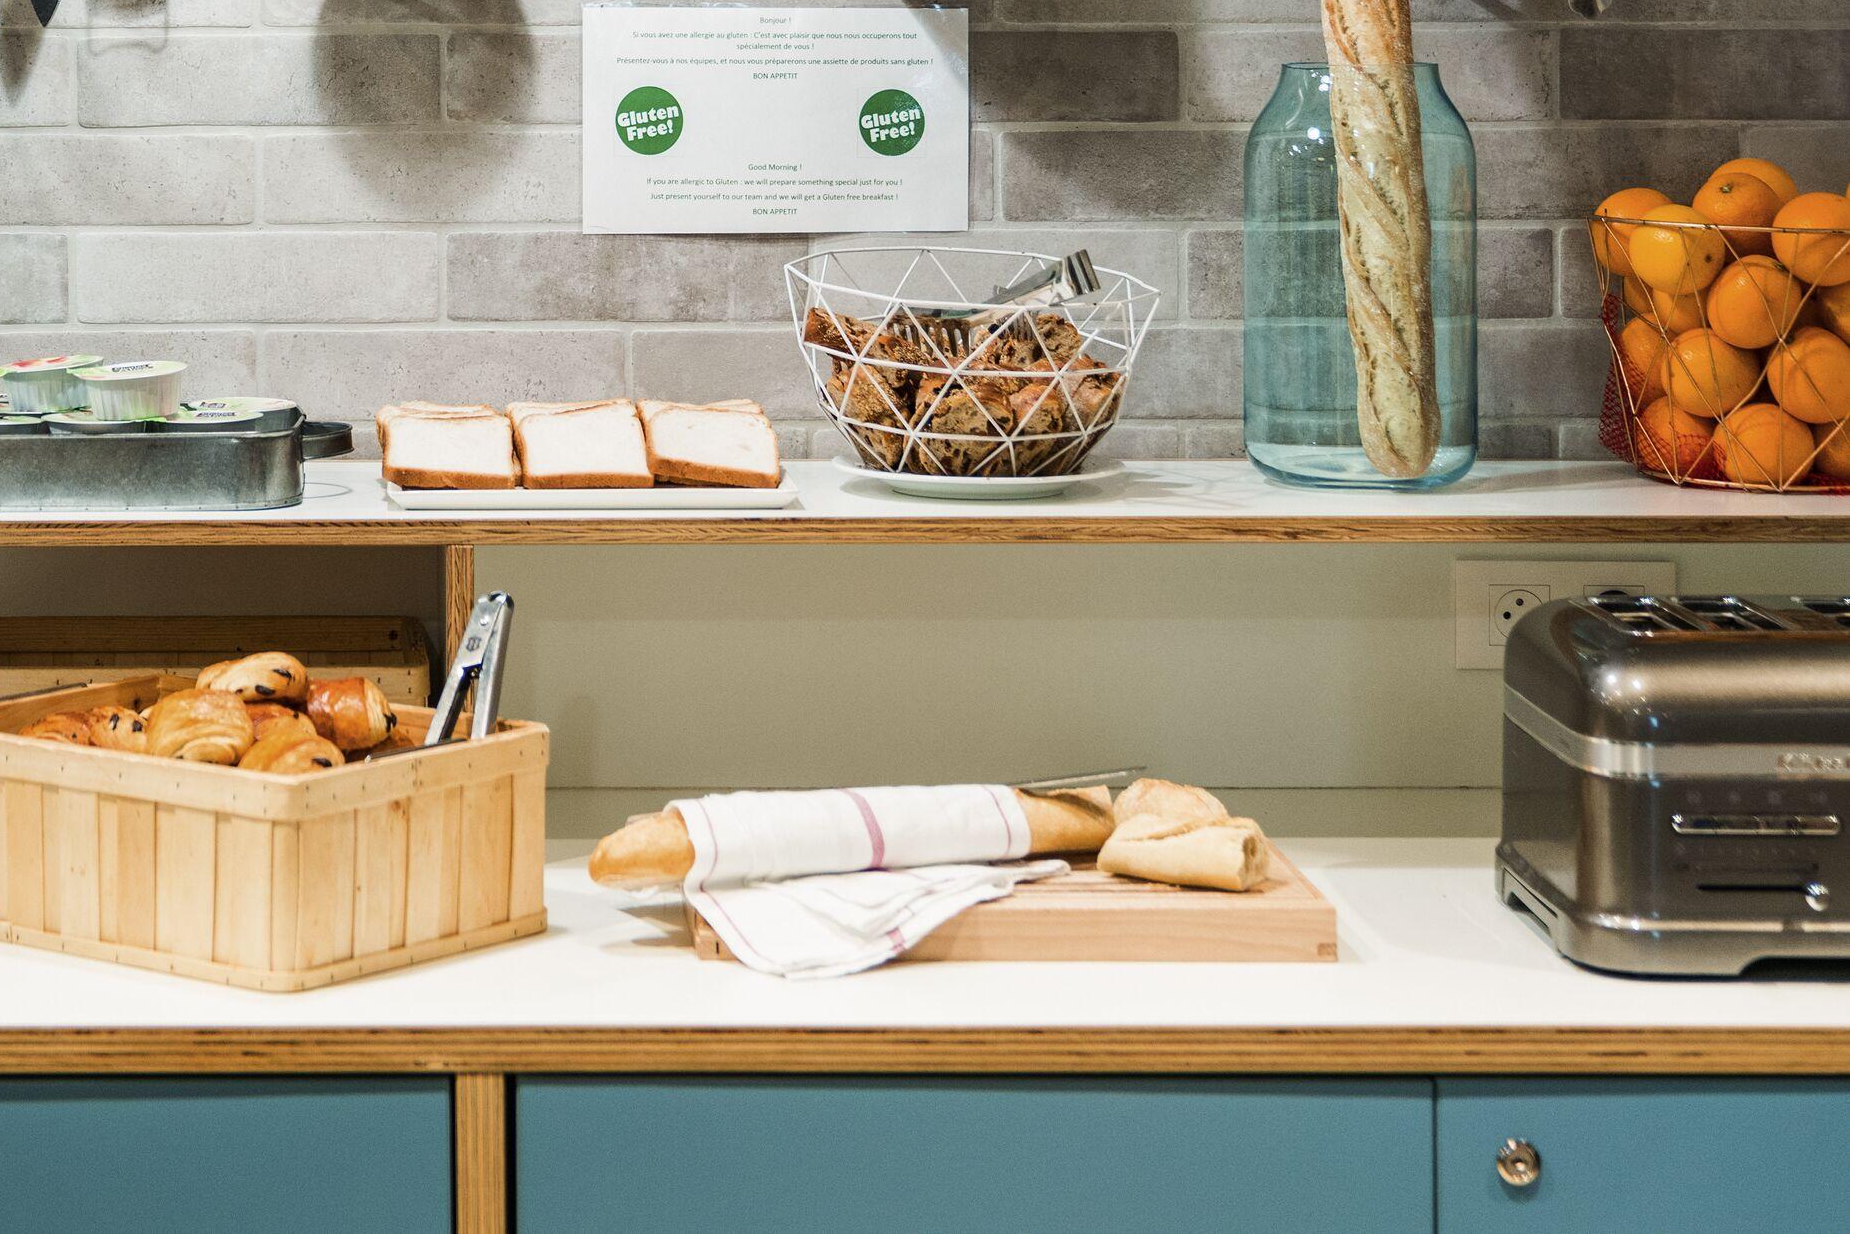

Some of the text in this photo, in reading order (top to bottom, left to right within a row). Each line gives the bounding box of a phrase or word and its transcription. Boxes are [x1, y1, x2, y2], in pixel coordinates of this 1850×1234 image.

[759, 17, 787, 26] Bonjour
[689, 32, 715, 41] allergie
[726, 32, 748, 41] gluten
[789, 32, 810, 41] plaisir
[811, 33, 824, 41] que
[736, 43, 782, 52] spécialement
[690, 58, 719, 66] équipes,
[764, 58, 806, 66] préparerons
[860, 58, 889, 67] produits
[906, 58, 929, 67] gluten
[617, 106, 680, 127] Gluten
[860, 108, 921, 129] Gluten
[626, 119, 674, 142] Free!
[870, 122, 915, 142] Free!
[768, 164, 798, 172] Morning
[680, 178, 704, 186] allergic
[798, 179, 834, 187] something
[834, 179, 858, 187] special
[859, 179, 872, 187] just
[666, 193, 692, 201] present
[693, 193, 721, 201] yourself
[804, 193, 816, 202] get
